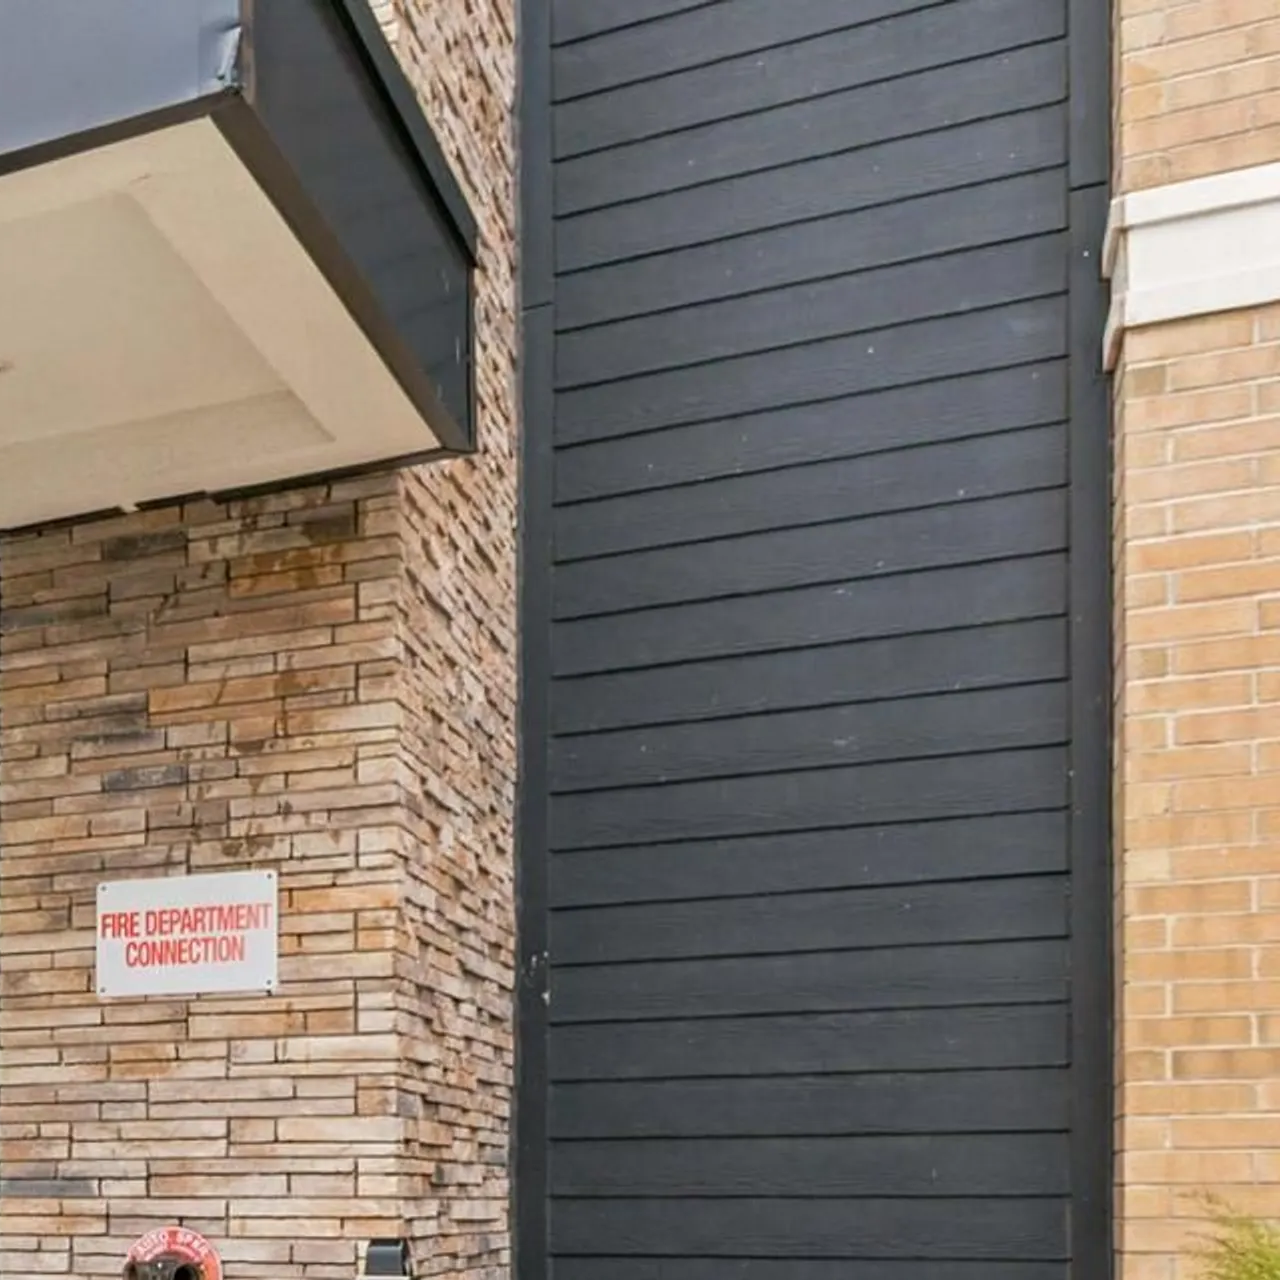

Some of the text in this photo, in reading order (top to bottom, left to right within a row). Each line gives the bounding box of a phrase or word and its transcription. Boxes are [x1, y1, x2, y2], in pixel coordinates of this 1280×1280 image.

[100, 902, 273, 940] FIRE DEPARTMENT
[125, 936, 246, 968] CONNECTION
